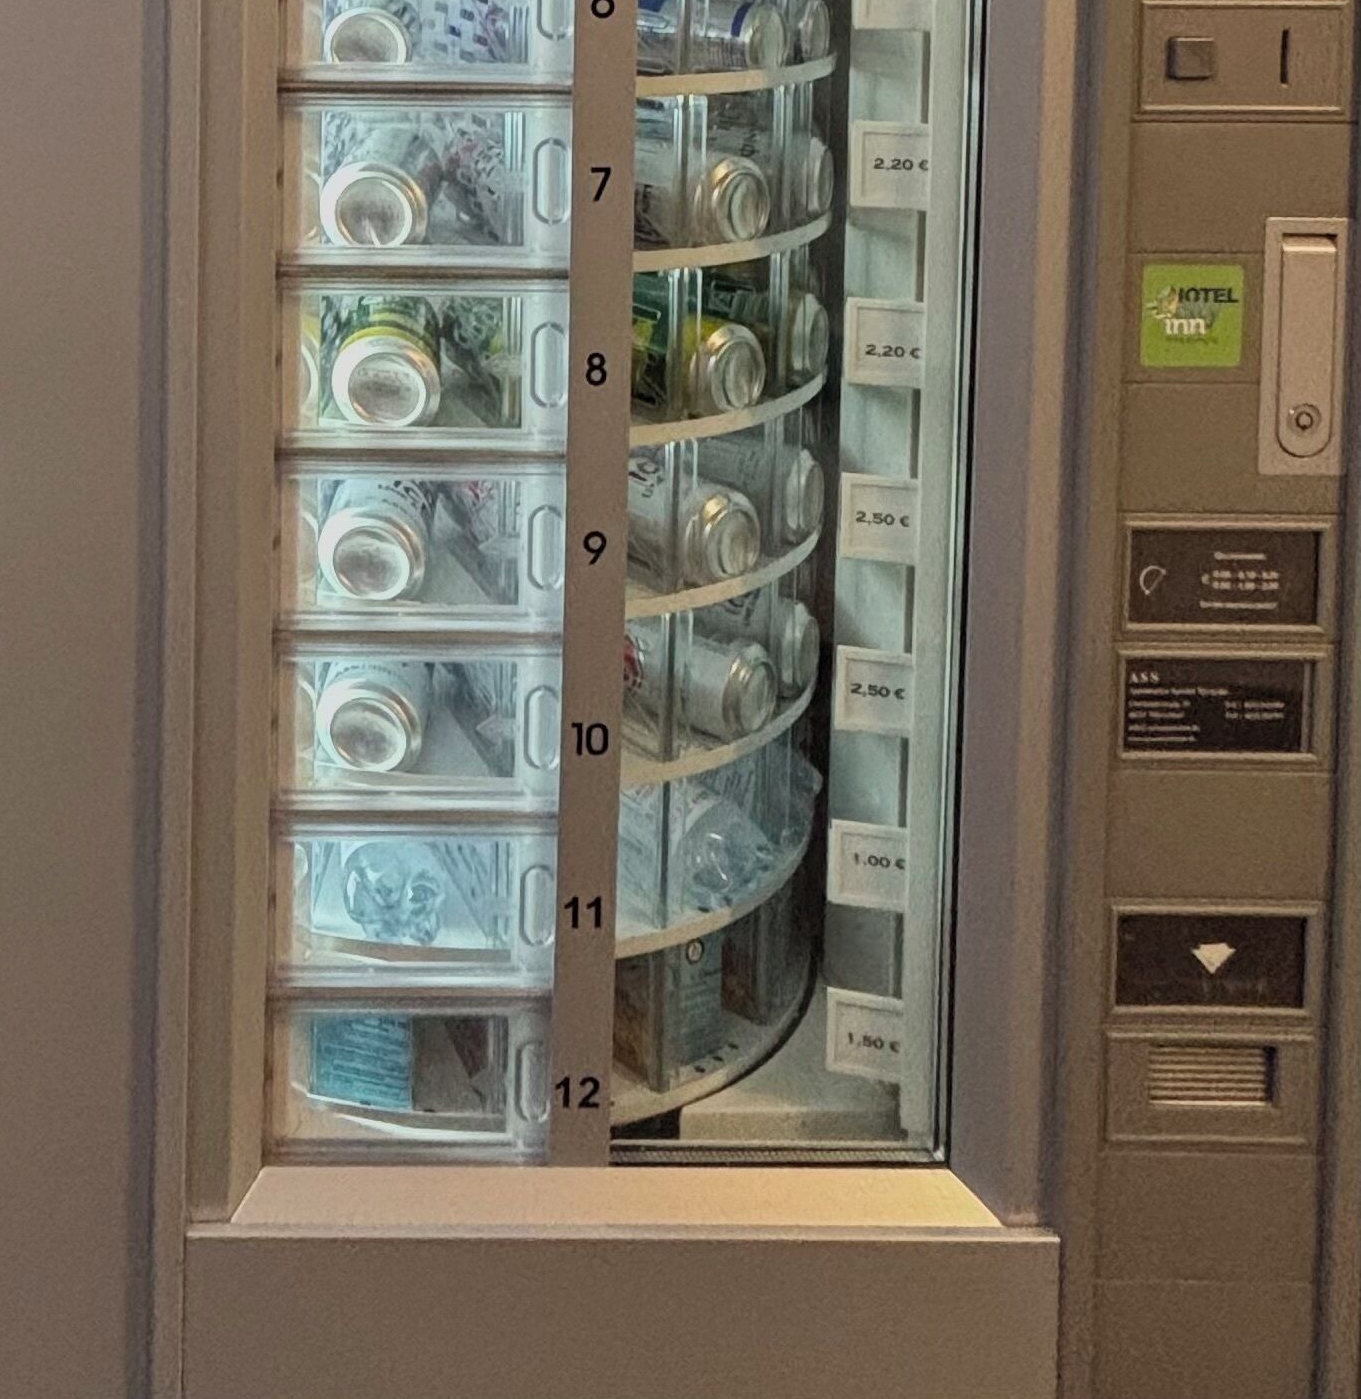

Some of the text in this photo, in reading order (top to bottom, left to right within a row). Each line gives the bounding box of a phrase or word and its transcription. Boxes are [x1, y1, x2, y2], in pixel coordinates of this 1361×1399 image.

[919, 159, 929, 172] €
[591, 167, 612, 202] 7
[1165, 317, 1206, 335] inn
[910, 347, 921, 359] €
[586, 353, 607, 386] 8
[899, 515, 910, 528] €
[583, 531, 607, 565] 9
[895, 688, 906, 700] €
[571, 722, 609, 756] 10
[895, 858, 906, 870] €
[564, 897, 603, 930] 11
[889, 1040, 900, 1054] €
[555, 1077, 600, 1109] 12
